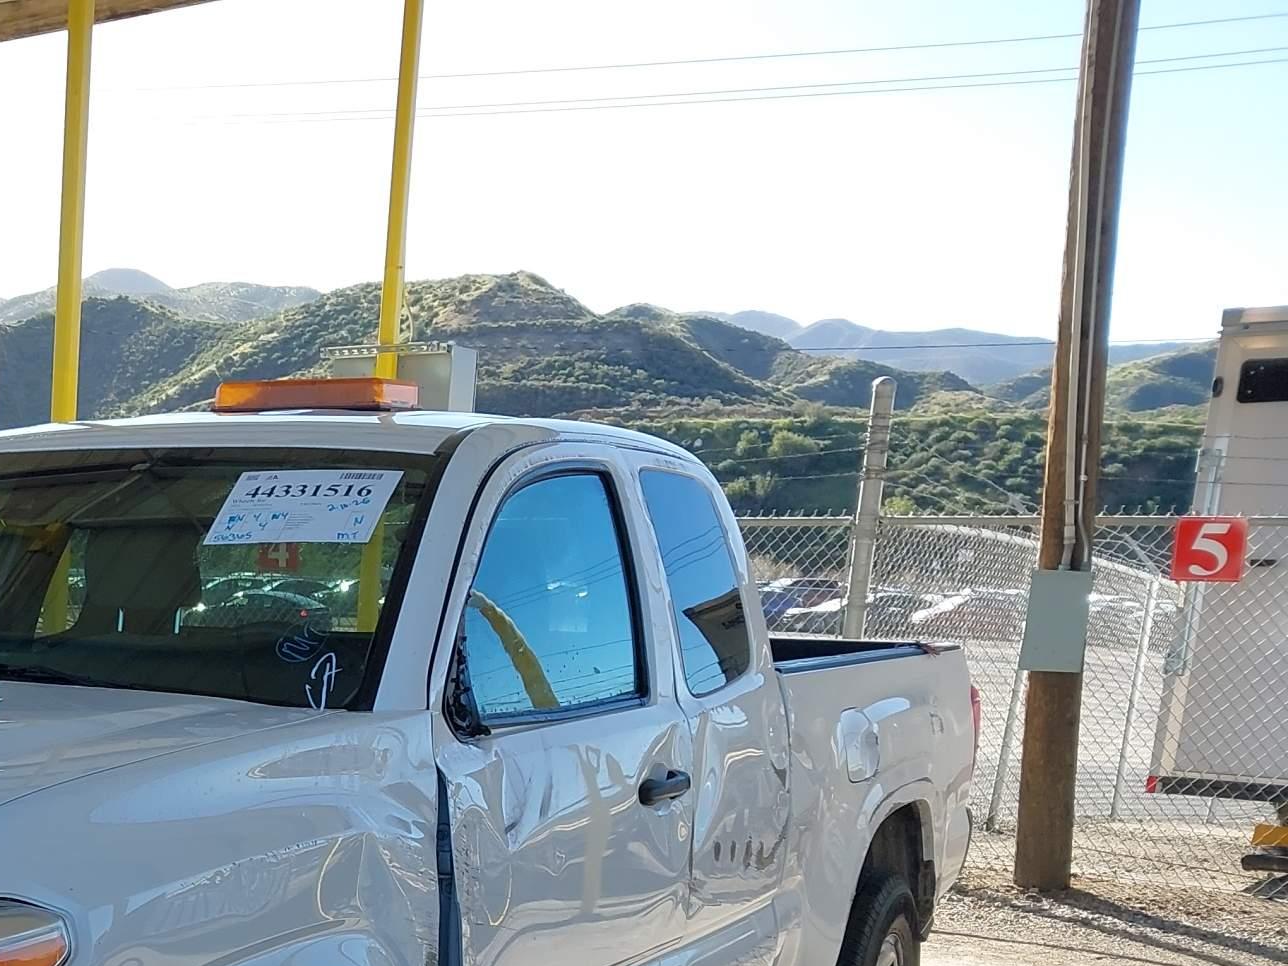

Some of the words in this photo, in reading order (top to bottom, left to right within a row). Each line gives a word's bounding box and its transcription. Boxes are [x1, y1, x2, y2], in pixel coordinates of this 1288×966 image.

[245, 483, 374, 498] 44331516
[267, 543, 289, 568] 4
[1188, 522, 1232, 576] 5
